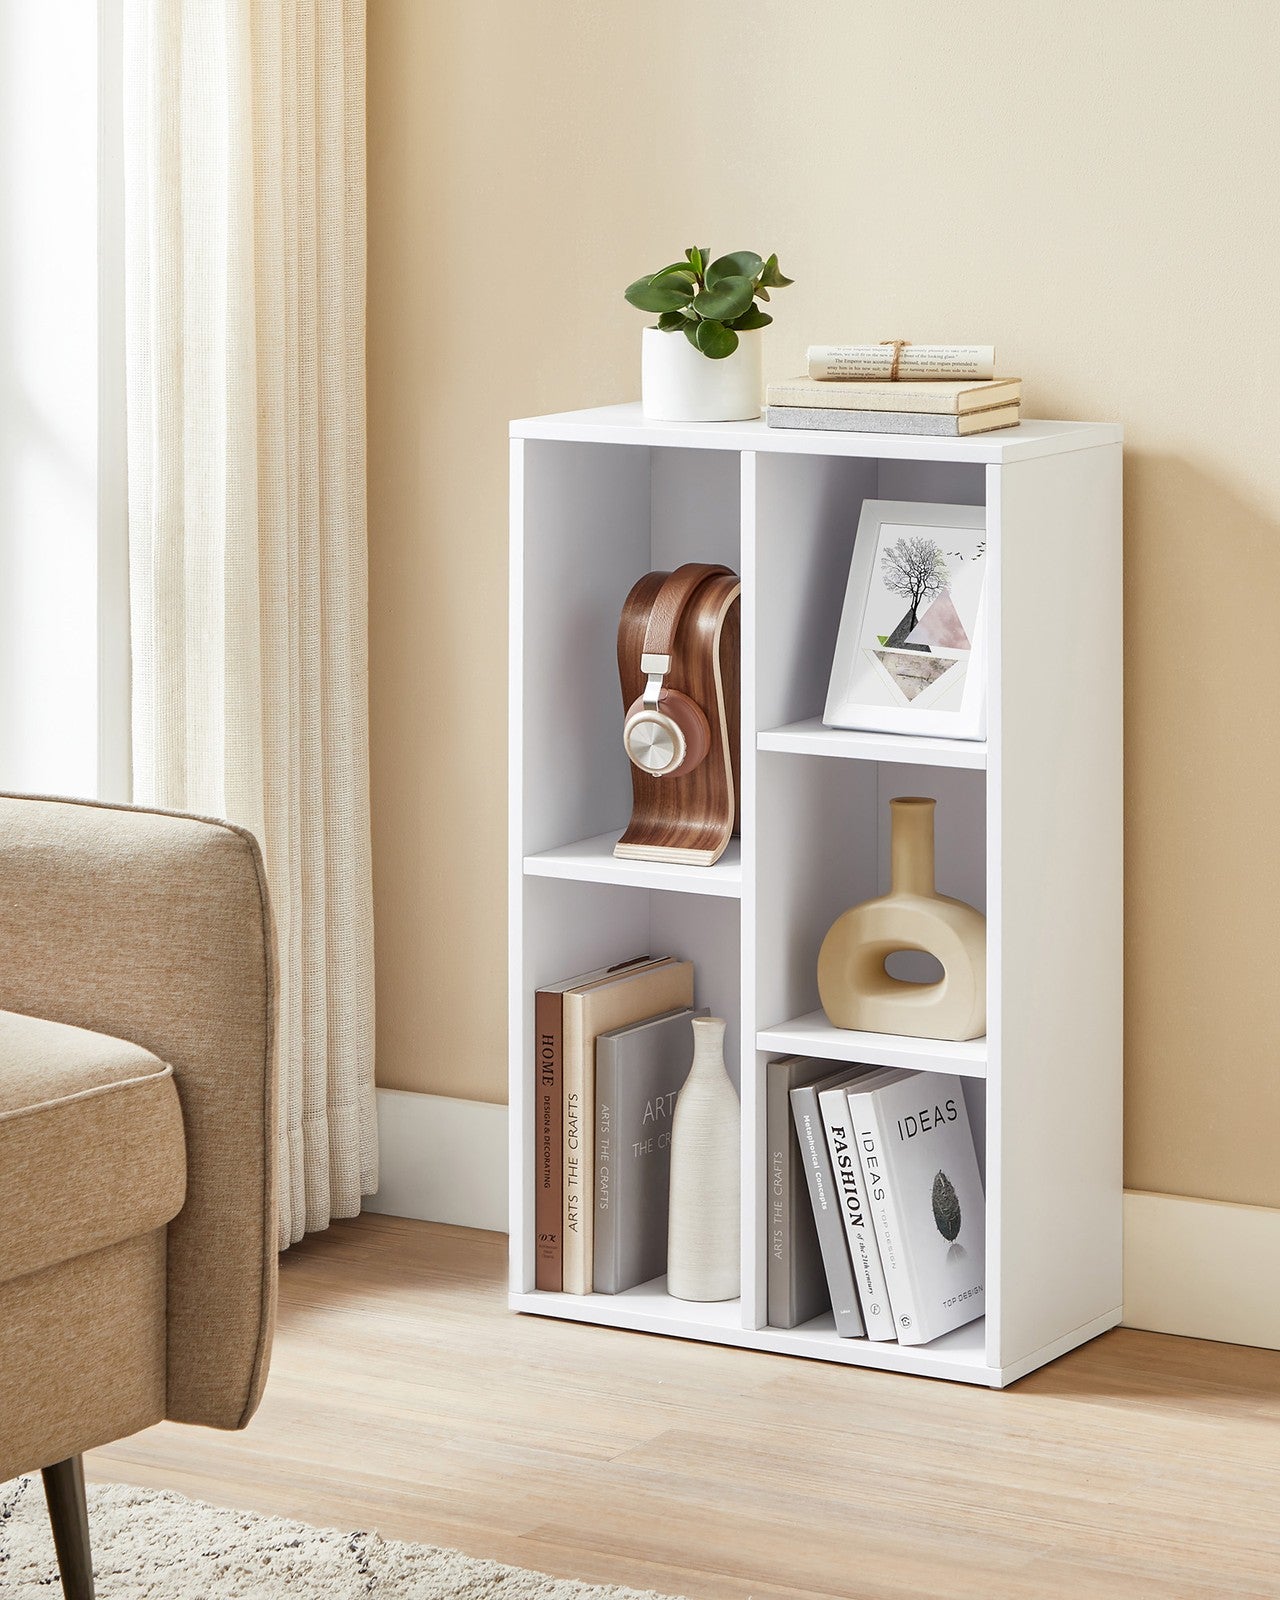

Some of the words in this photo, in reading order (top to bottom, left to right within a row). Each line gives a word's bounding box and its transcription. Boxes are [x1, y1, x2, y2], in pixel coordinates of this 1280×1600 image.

[542, 1034, 554, 1087] HOME
[568, 1093, 579, 1150] CRAFTS
[600, 1104, 610, 1133] ARTS
[642, 1091, 677, 1125] ART
[898, 1100, 958, 1140] IDEAS
[600, 1140, 610, 1161] THE
[632, 1138, 654, 1158] THE
[804, 1115, 820, 1168] Metaphorical
[816, 1172, 828, 1210] Concepts
[861, 1131, 885, 1201] IDEAS
[568, 1157, 578, 1187] THE
[600, 1166, 610, 1210] CRAFTS
[774, 1152, 784, 1196] CRAFTS
[832, 1126, 864, 1228] FASHION
[568, 1196, 578, 1232] ARTS
[774, 1201, 782, 1226] THE
[774, 1230, 783, 1260] ARTS
[942, 1296, 956, 1308] TOP
[958, 1284, 984, 1302] DESIGN
